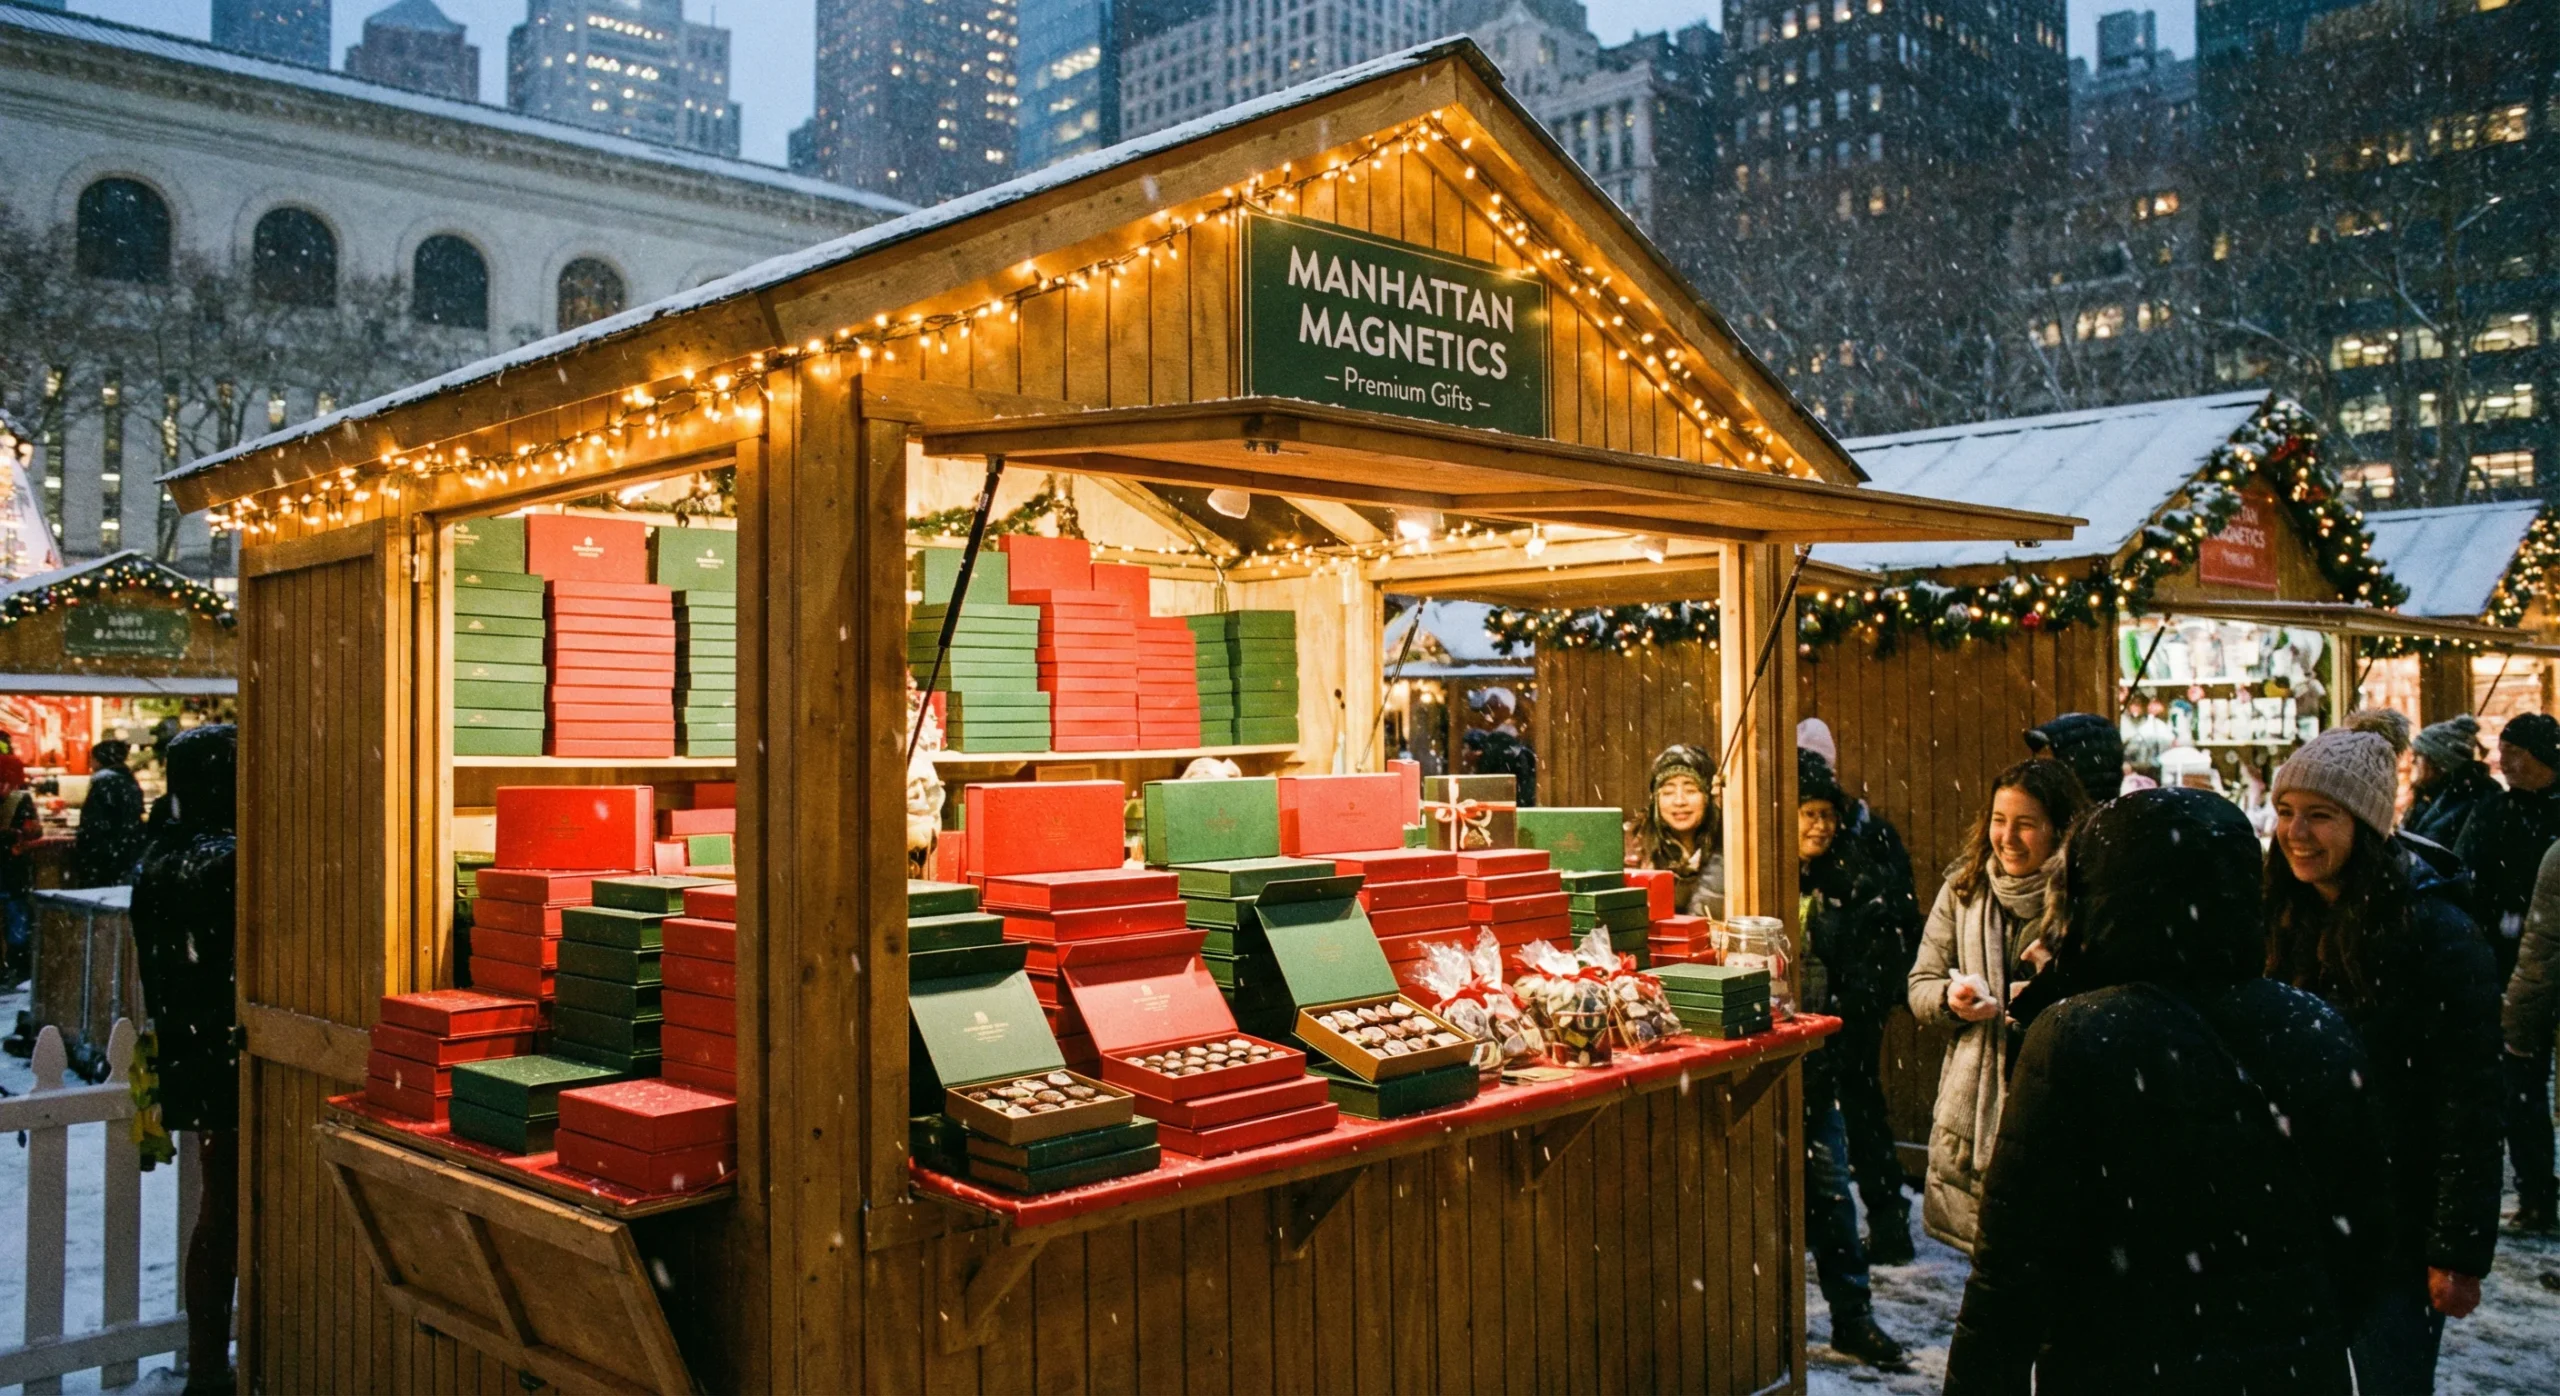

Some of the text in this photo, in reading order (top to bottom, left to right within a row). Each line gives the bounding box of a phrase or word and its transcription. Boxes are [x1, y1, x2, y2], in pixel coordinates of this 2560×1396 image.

[1288, 245, 1513, 333] MANHATTAN
[1299, 303, 1508, 380] MAGNETICS
[1344, 366, 1473, 412] Premium Gifts
